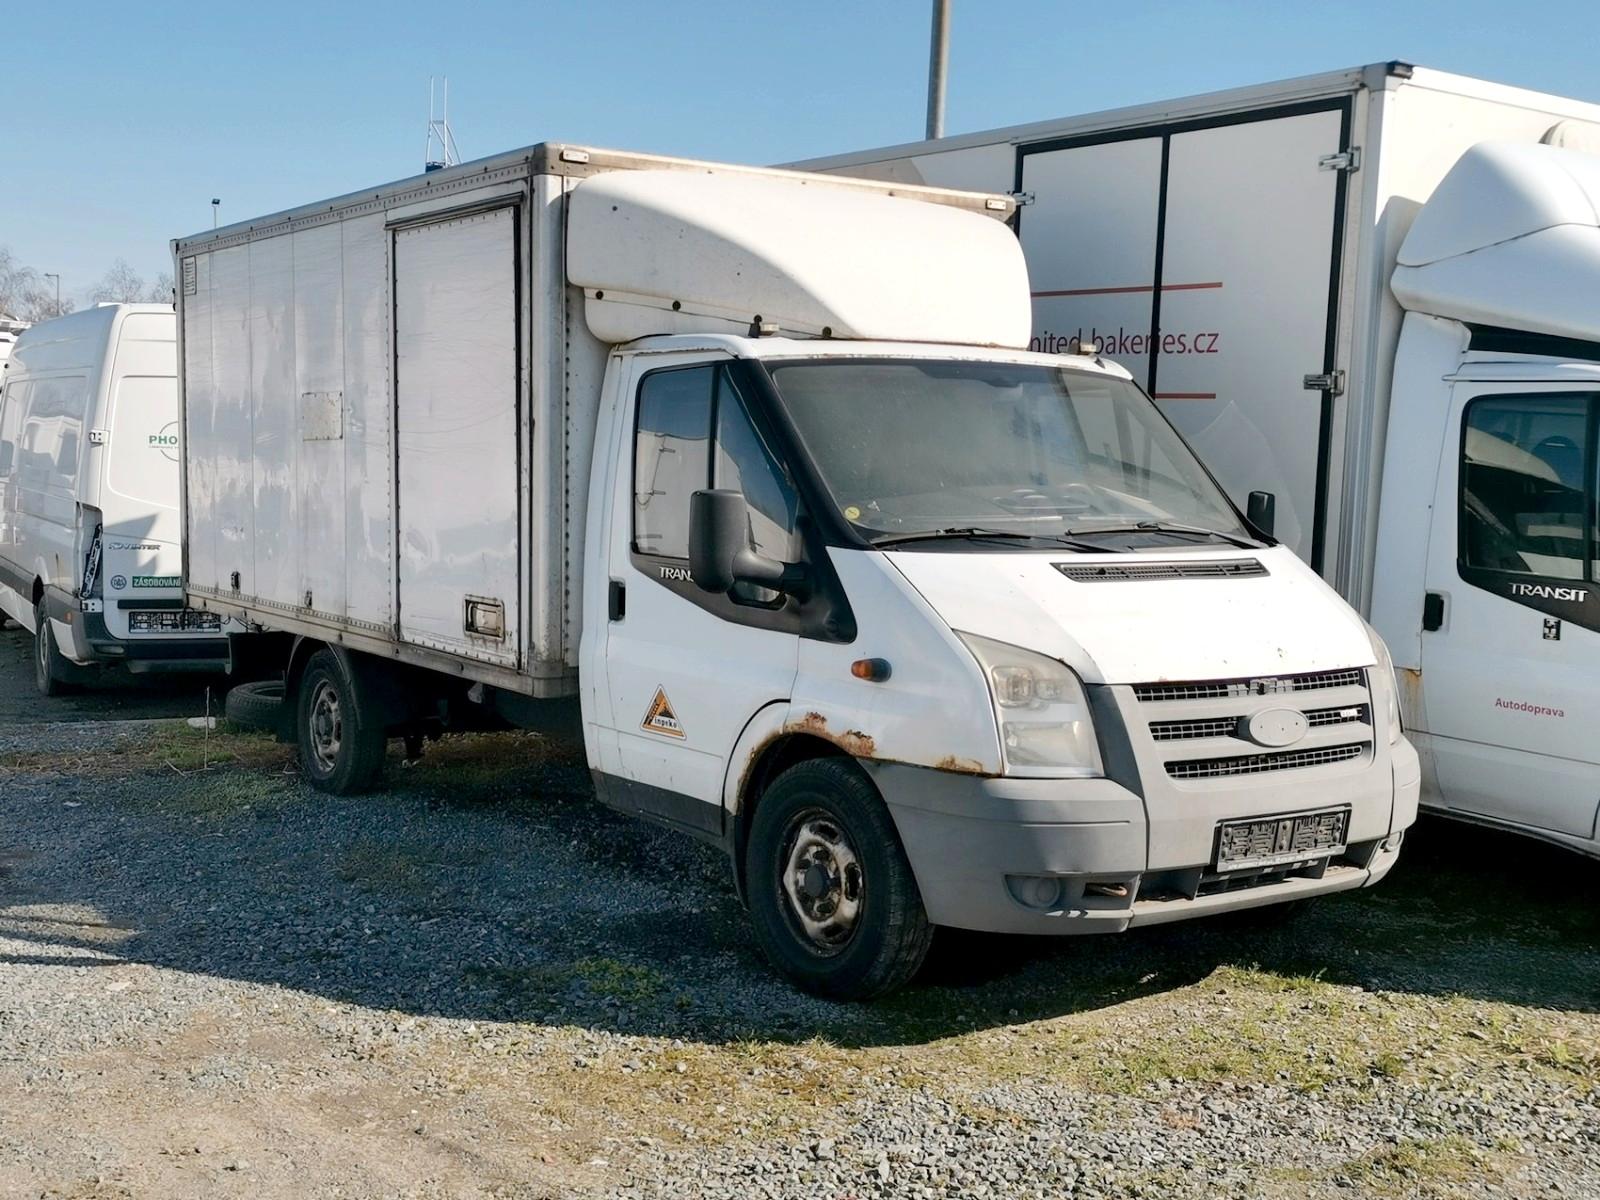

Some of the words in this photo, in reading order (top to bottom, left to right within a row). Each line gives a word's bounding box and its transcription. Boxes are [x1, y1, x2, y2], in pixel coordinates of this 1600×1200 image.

[1030, 327, 1082, 354] nited
[1092, 327, 1219, 355] bakeres.cz
[149, 435, 178, 445] PHO
[1509, 583, 1588, 602] TRANSIT
[1495, 698, 1564, 717] Autodoprava
